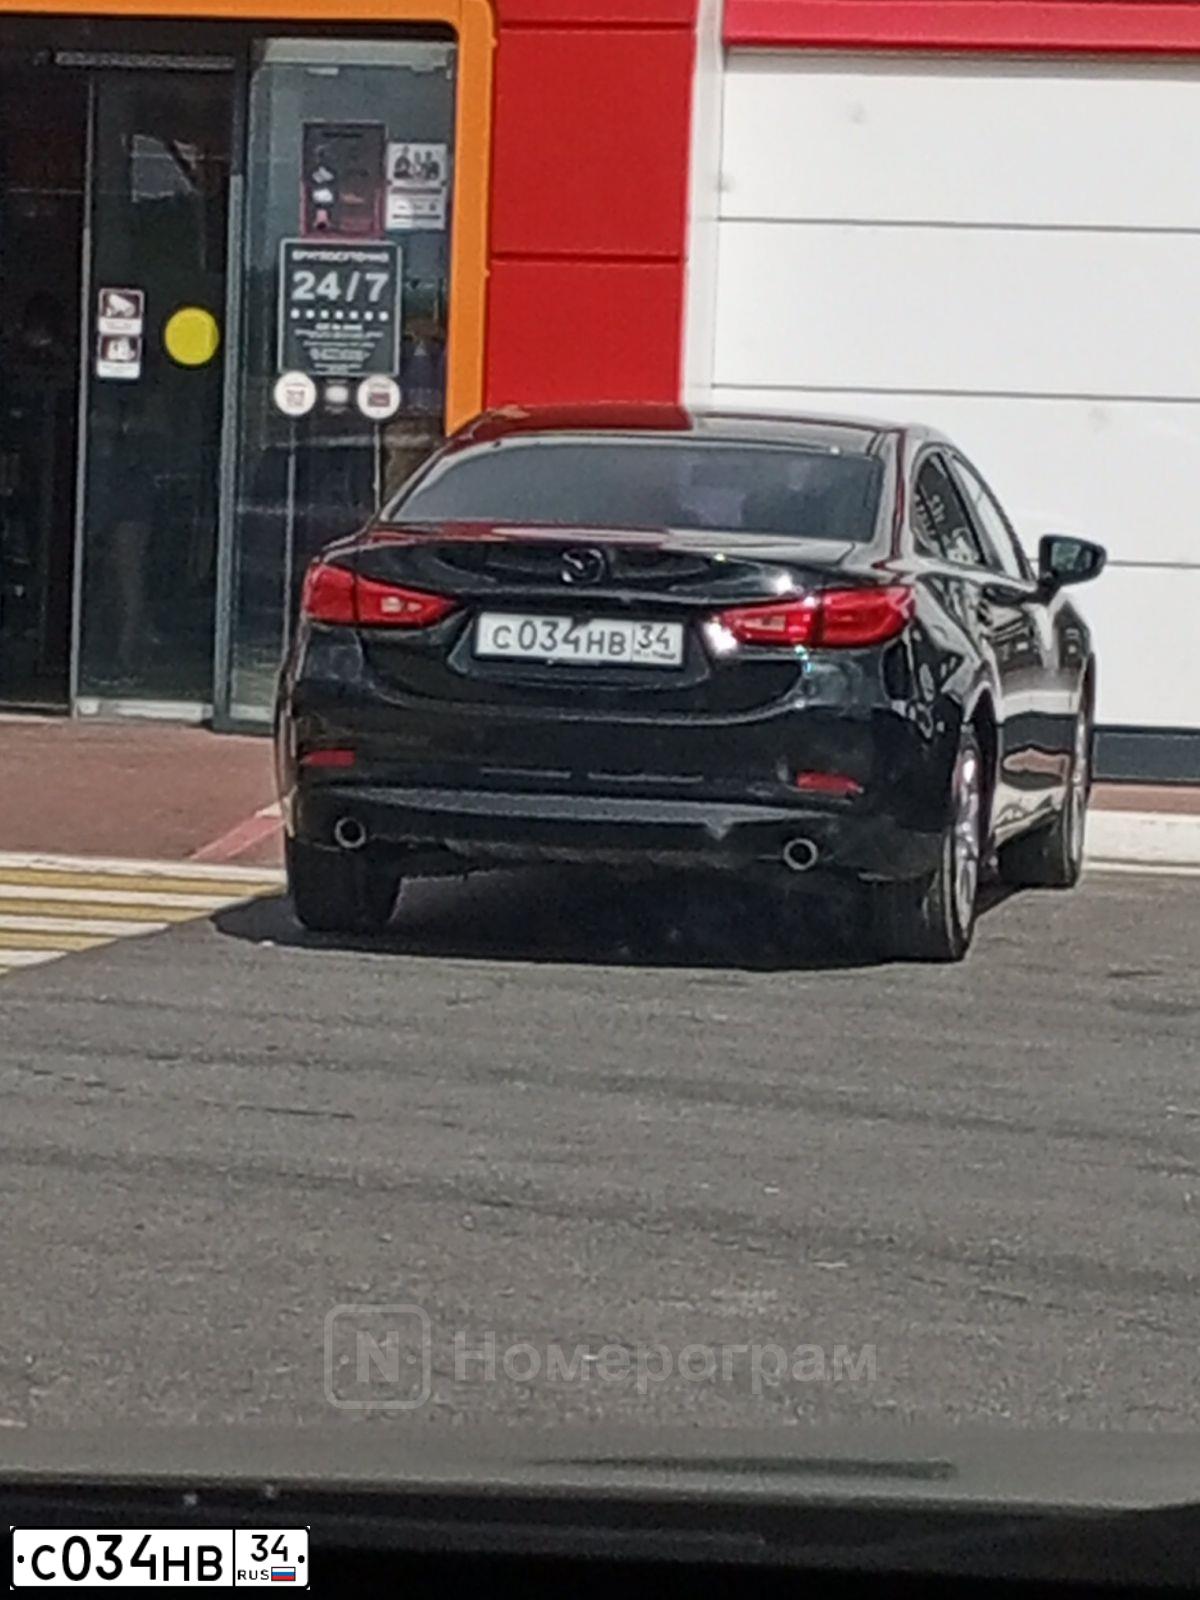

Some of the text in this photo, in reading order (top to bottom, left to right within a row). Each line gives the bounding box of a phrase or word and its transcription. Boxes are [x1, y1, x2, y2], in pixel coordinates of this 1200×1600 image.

[291, 270, 389, 302] 24/7
[492, 620, 670, 656] С034НВ 34
